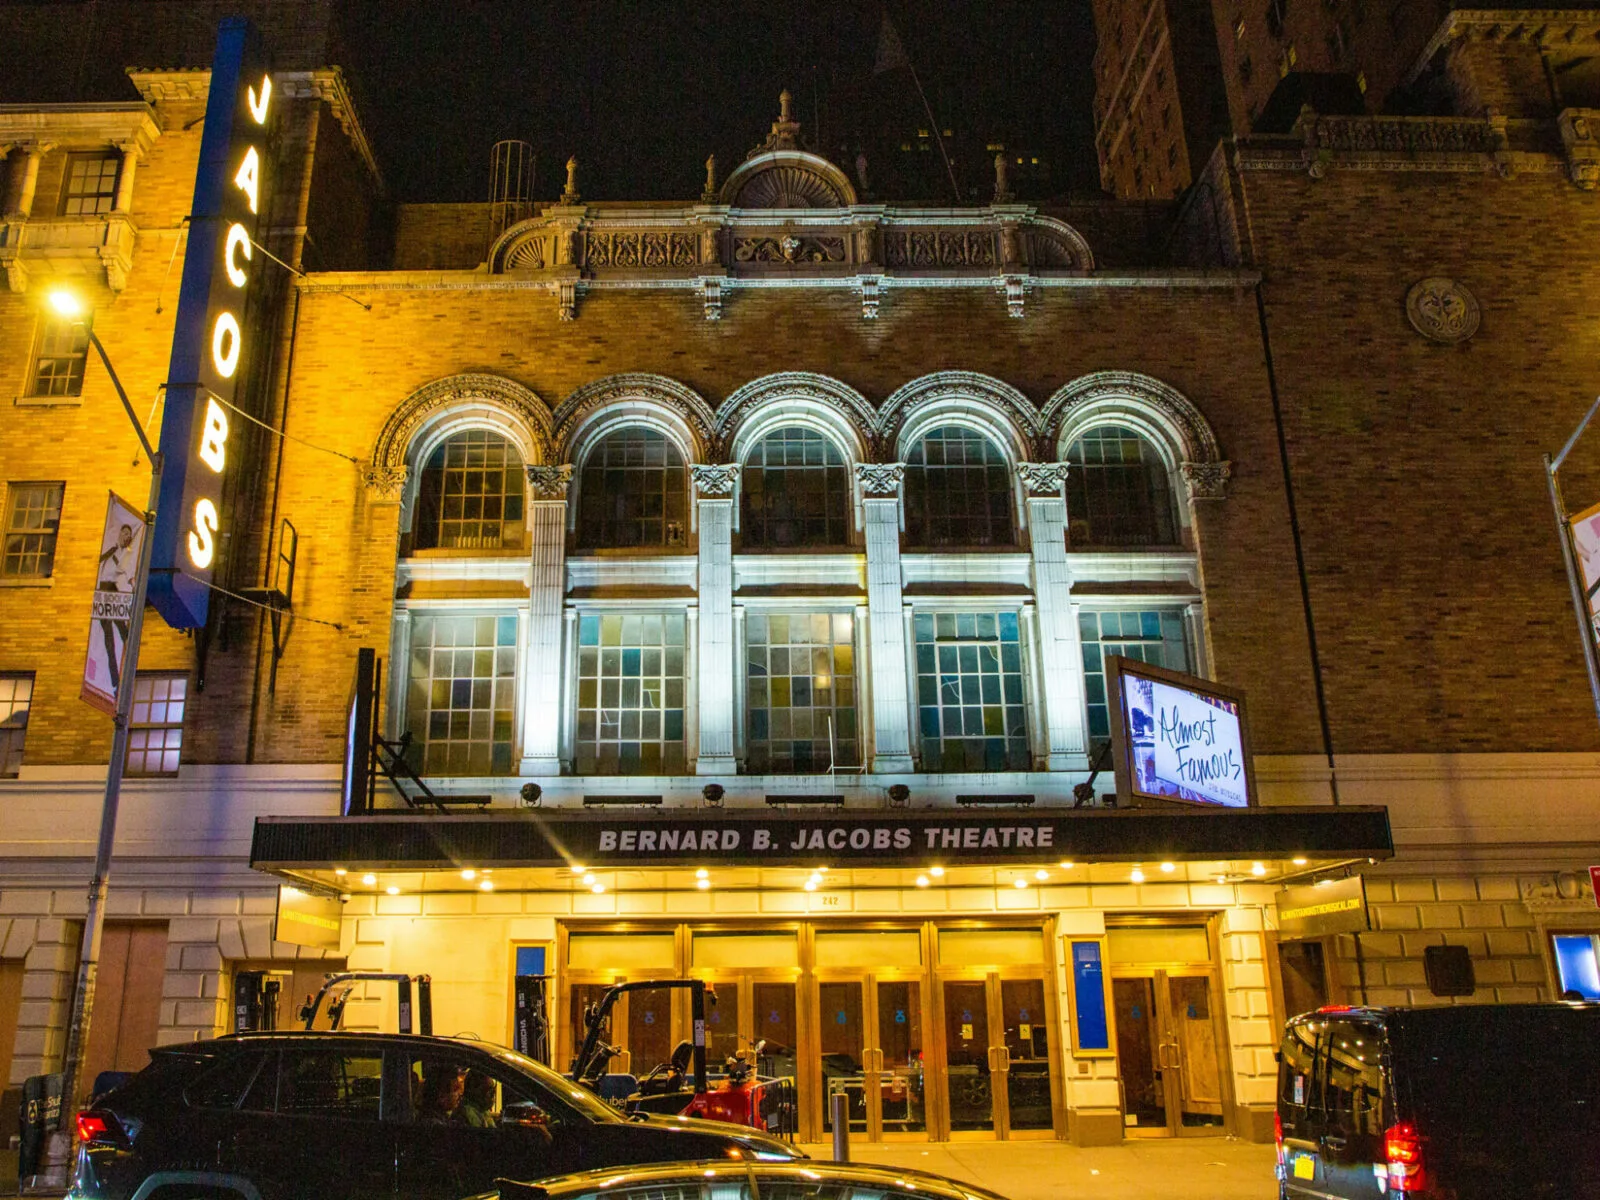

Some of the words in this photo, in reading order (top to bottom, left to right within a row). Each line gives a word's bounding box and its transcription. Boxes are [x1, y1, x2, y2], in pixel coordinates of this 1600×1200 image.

[188, 73, 272, 570] JACOBS
[92, 602, 131, 618] MORMON
[1158, 705, 1217, 749] Almost
[1176, 744, 1241, 786] Famous
[599, 830, 740, 851] BERNARD
[752, 830, 778, 849] B.
[790, 828, 911, 849] JACOBS
[924, 826, 1053, 848] THEATRE
